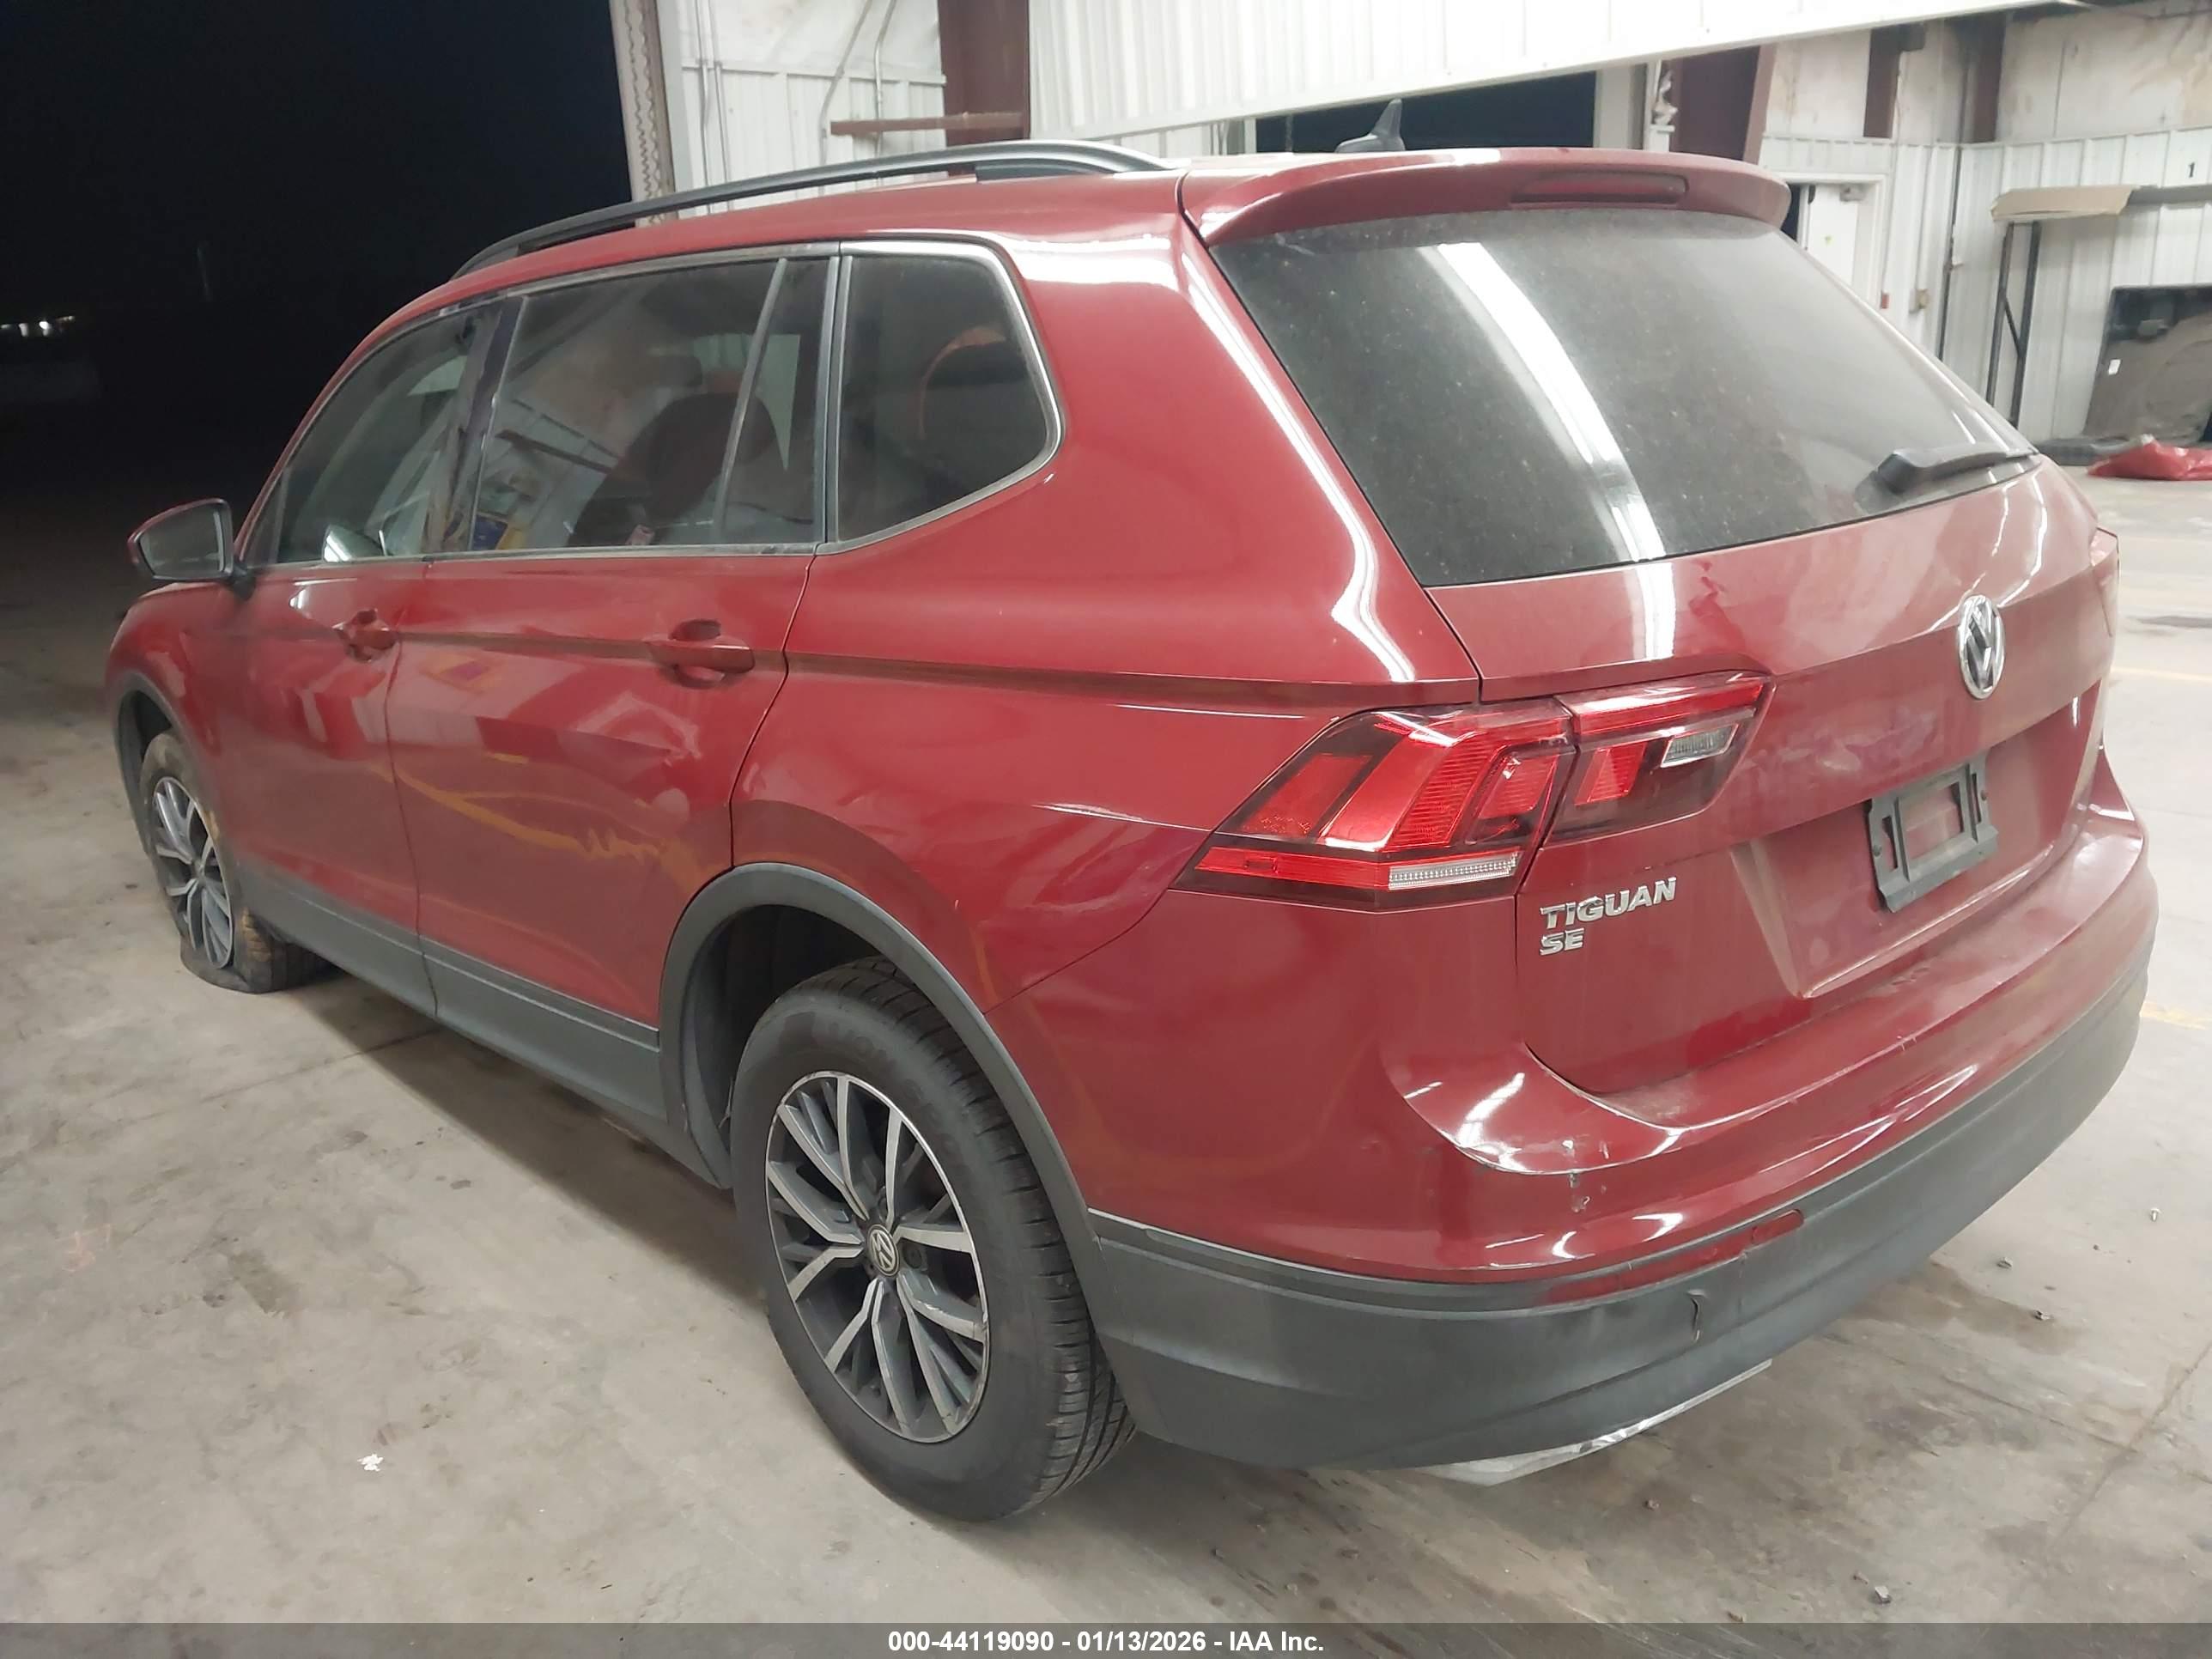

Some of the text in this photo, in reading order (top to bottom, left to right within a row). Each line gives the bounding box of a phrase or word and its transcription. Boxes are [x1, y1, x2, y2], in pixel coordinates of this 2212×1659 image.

[2188, 161, 2196, 179] 1
[1540, 877, 1677, 929] TIGUAN
[1540, 927, 1584, 956] SE
